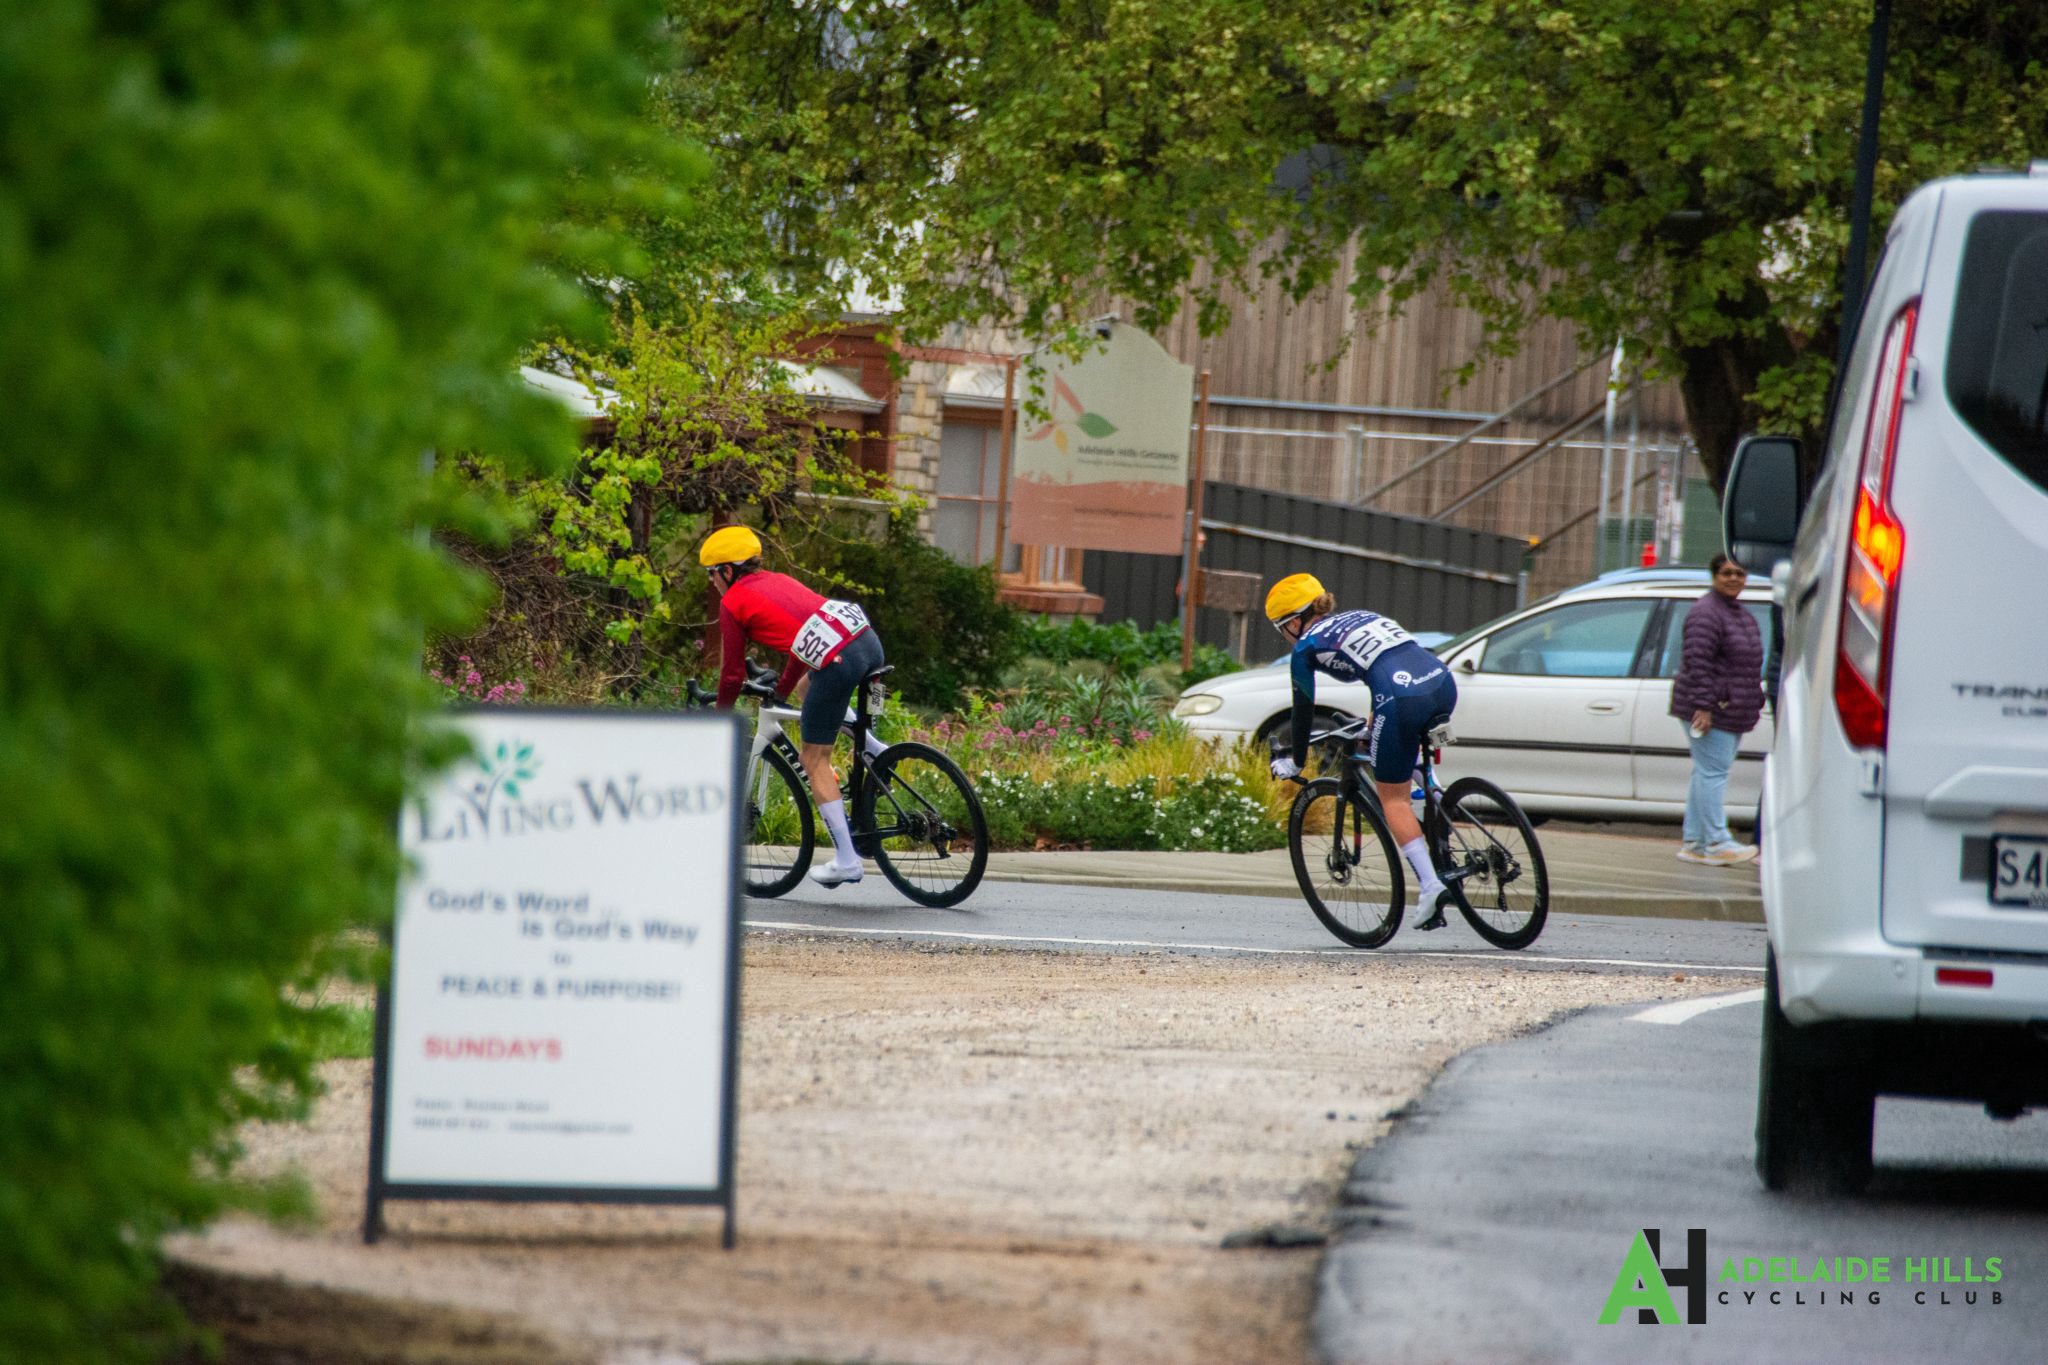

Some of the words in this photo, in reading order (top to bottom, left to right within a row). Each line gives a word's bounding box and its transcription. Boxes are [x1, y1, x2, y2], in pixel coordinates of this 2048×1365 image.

[797, 629, 832, 662] 507
[1347, 630, 1382, 662] 212
[517, 891, 590, 914] Word
[643, 918, 699, 946] Way
[441, 975, 521, 996] PEACE
[424, 1036, 563, 1061] SUNDAYS
